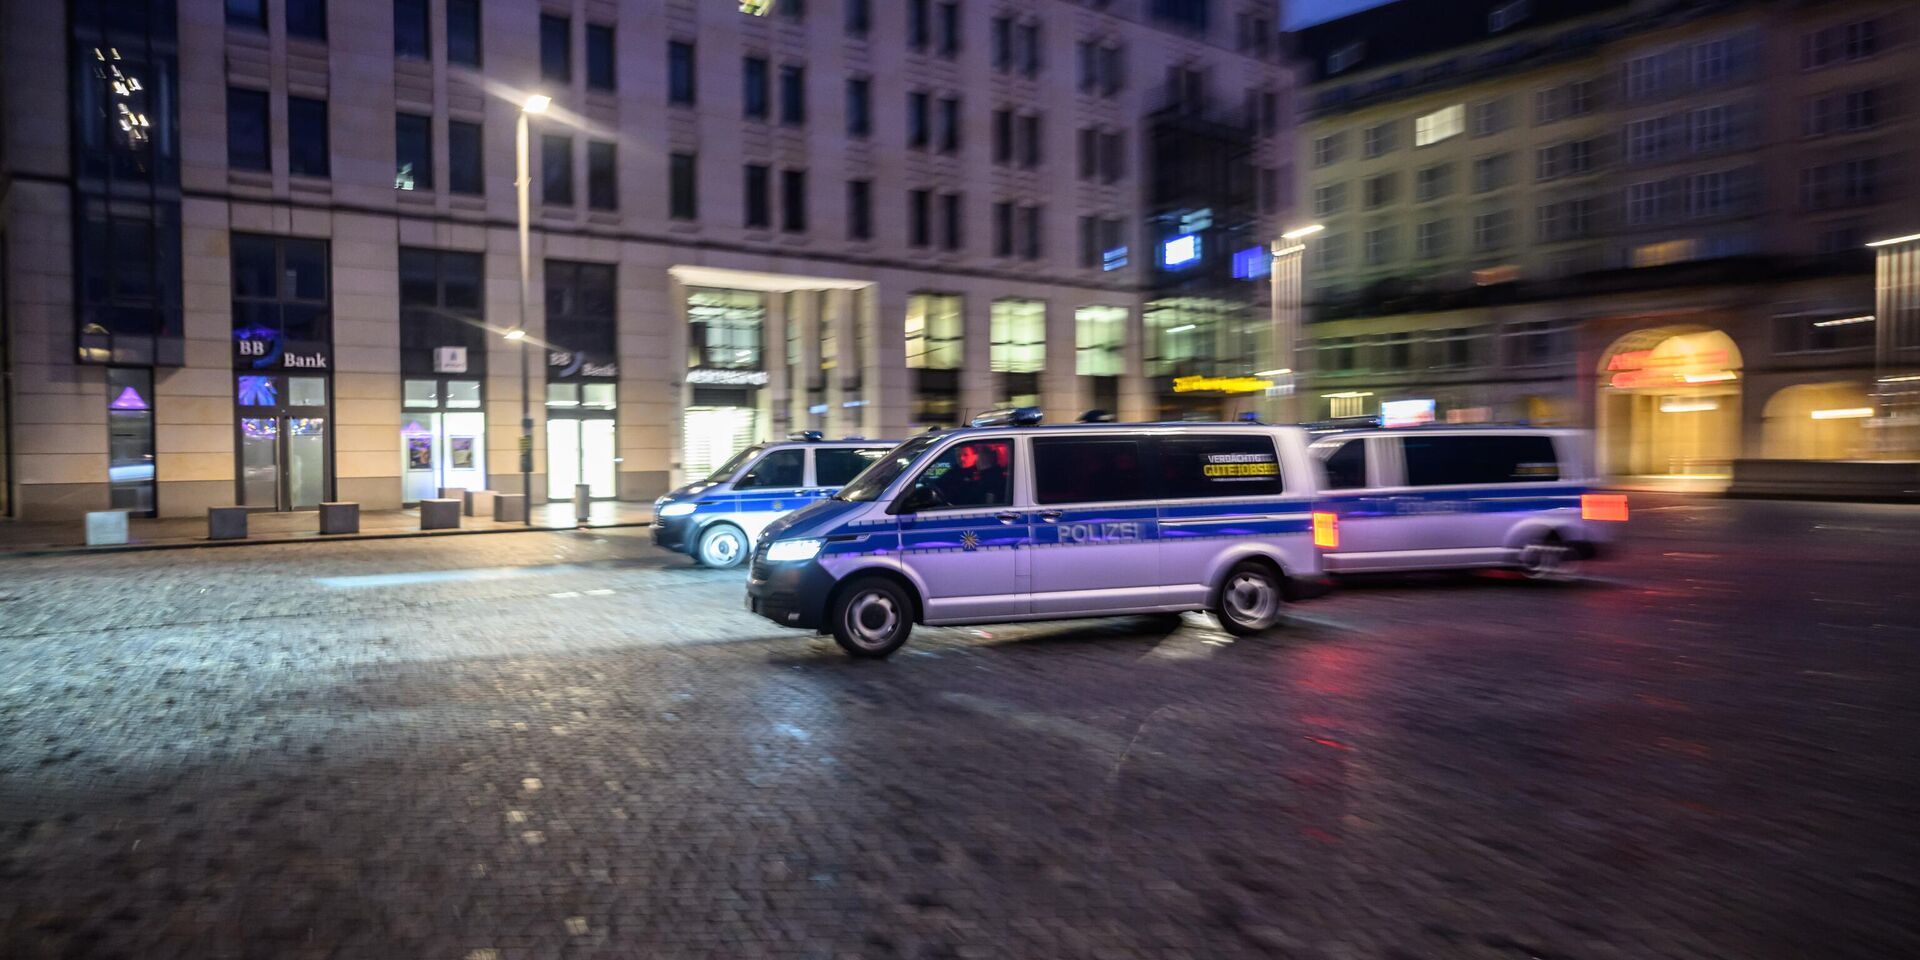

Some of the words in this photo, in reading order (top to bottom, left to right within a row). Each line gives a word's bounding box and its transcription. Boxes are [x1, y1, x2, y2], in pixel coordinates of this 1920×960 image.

[240, 340, 264, 355] BB
[284, 352, 326, 367] Bank
[1057, 522, 1139, 543] POLIZEI
